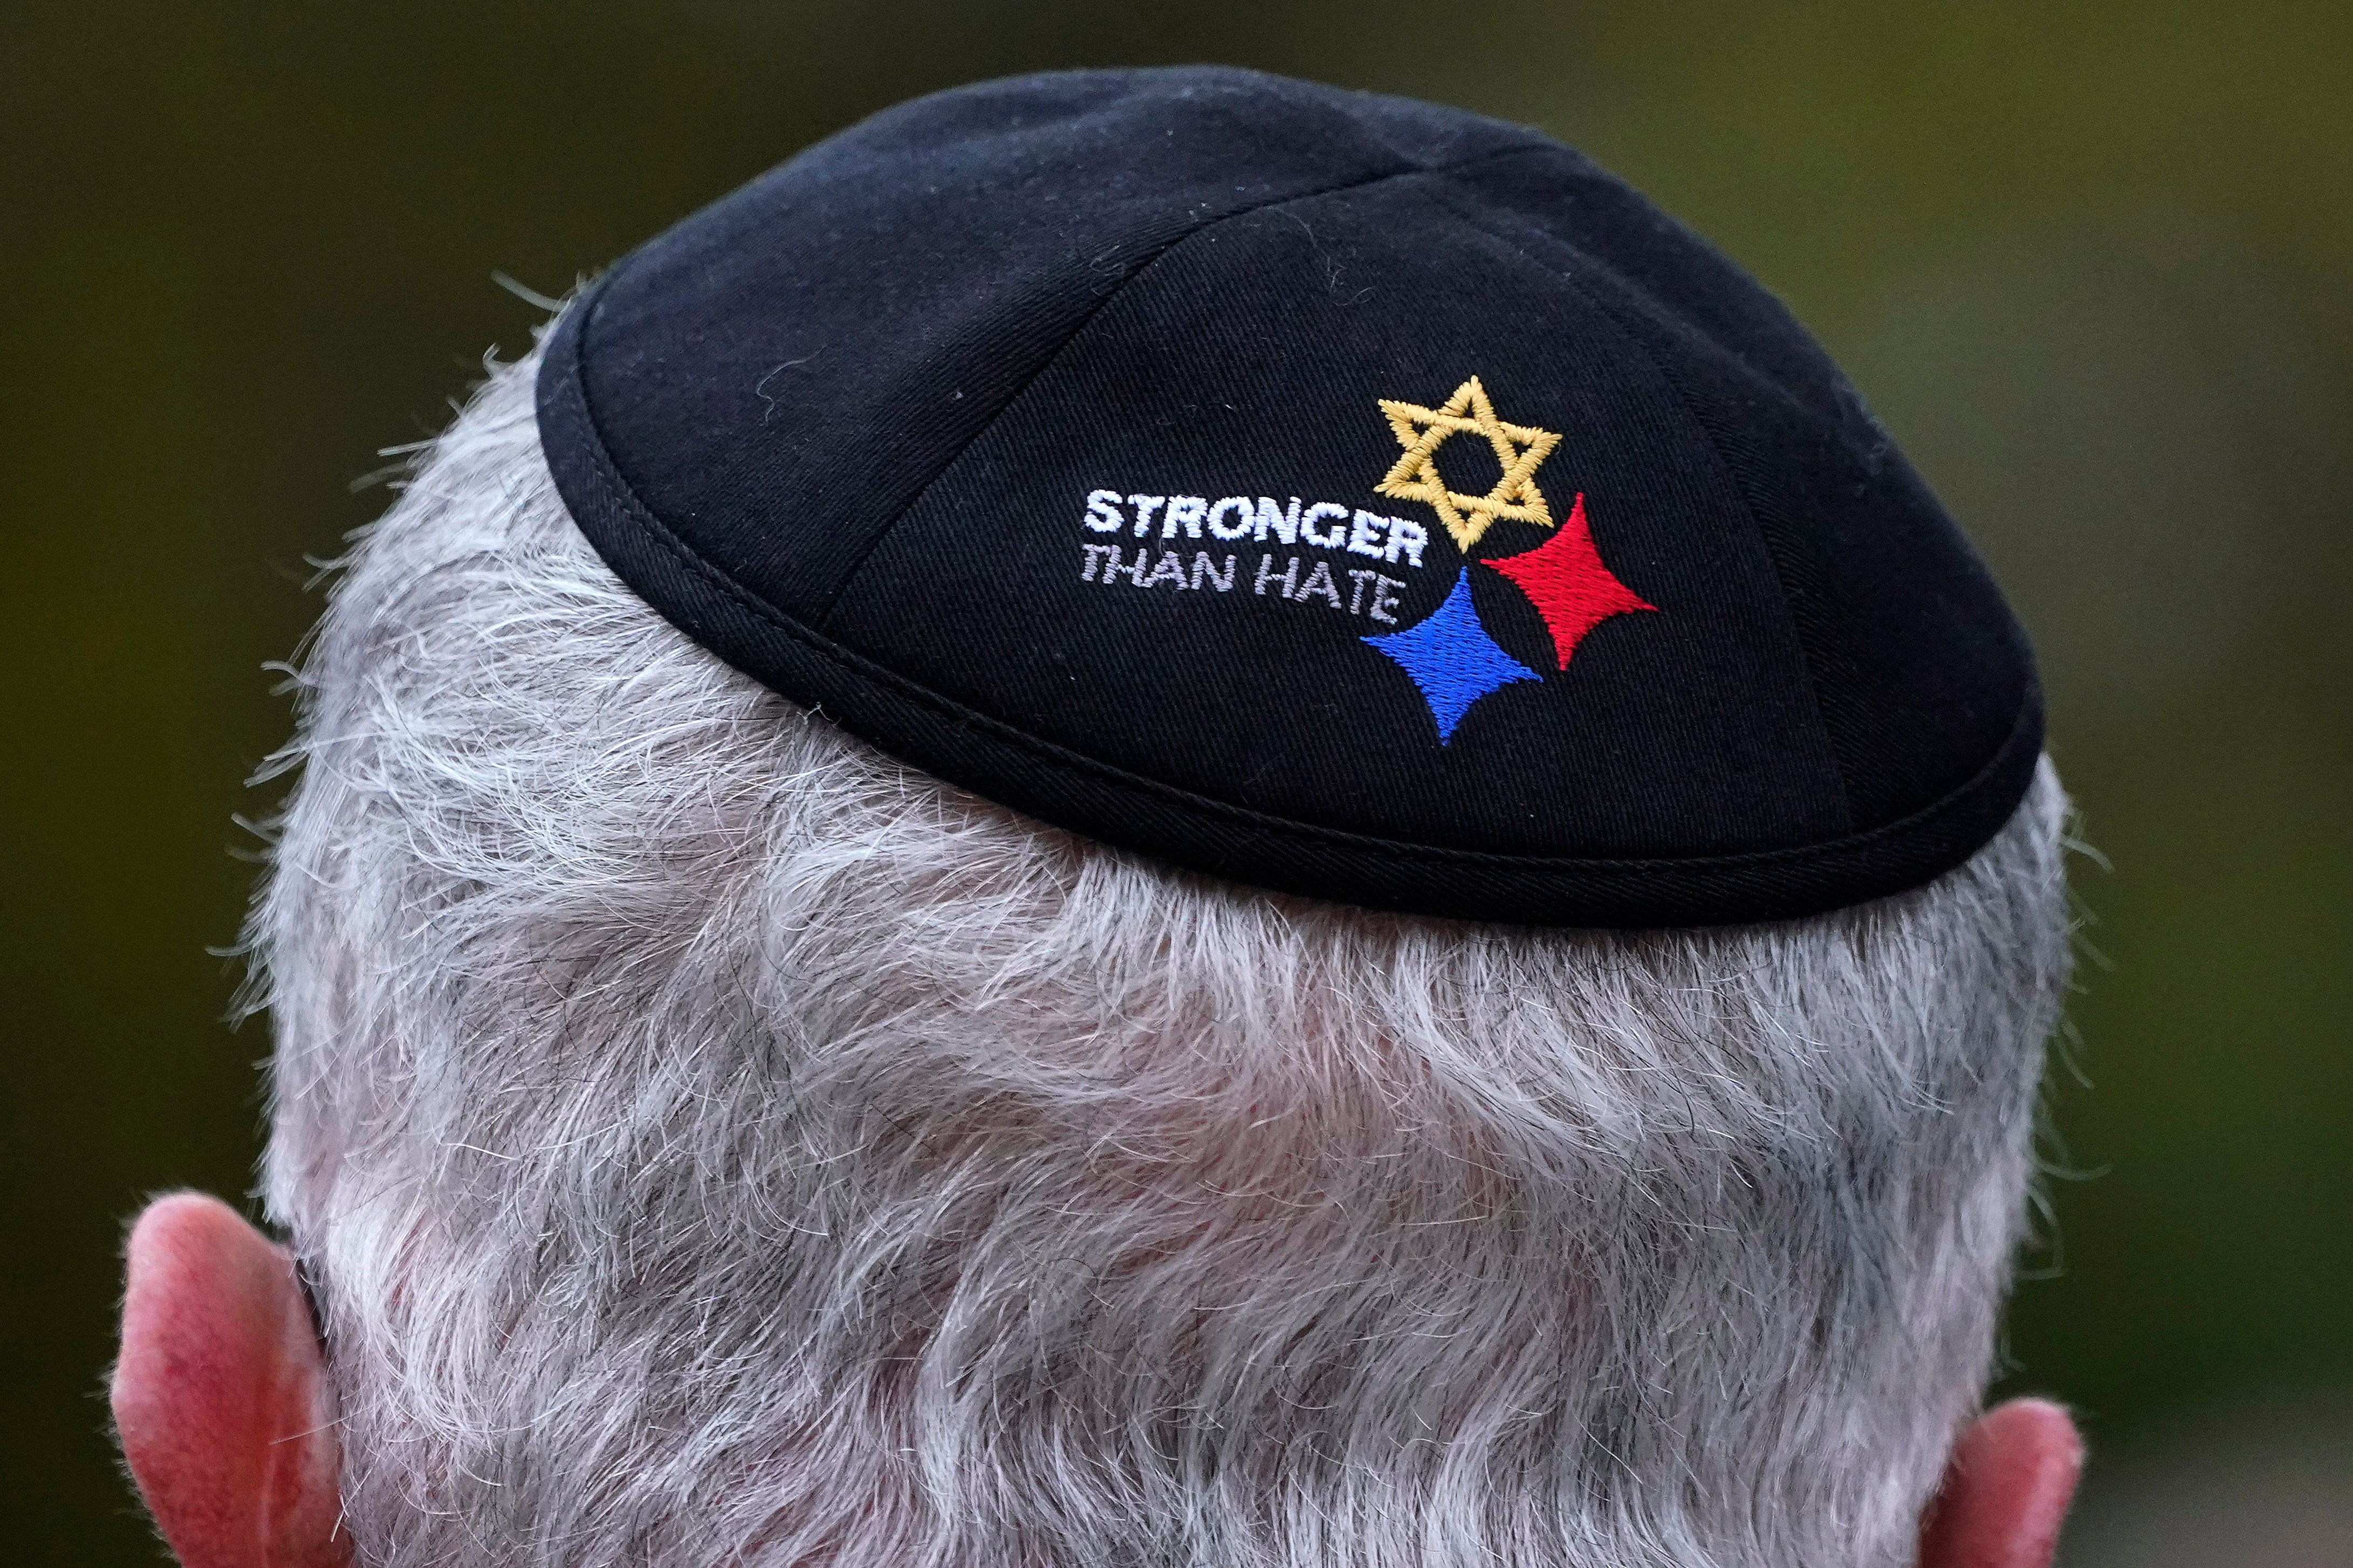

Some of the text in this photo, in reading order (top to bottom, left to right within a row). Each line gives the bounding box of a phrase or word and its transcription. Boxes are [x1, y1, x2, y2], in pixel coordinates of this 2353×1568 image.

[1083, 489, 1429, 568] STRONGER
[1081, 544, 1406, 625] THAN HATE
